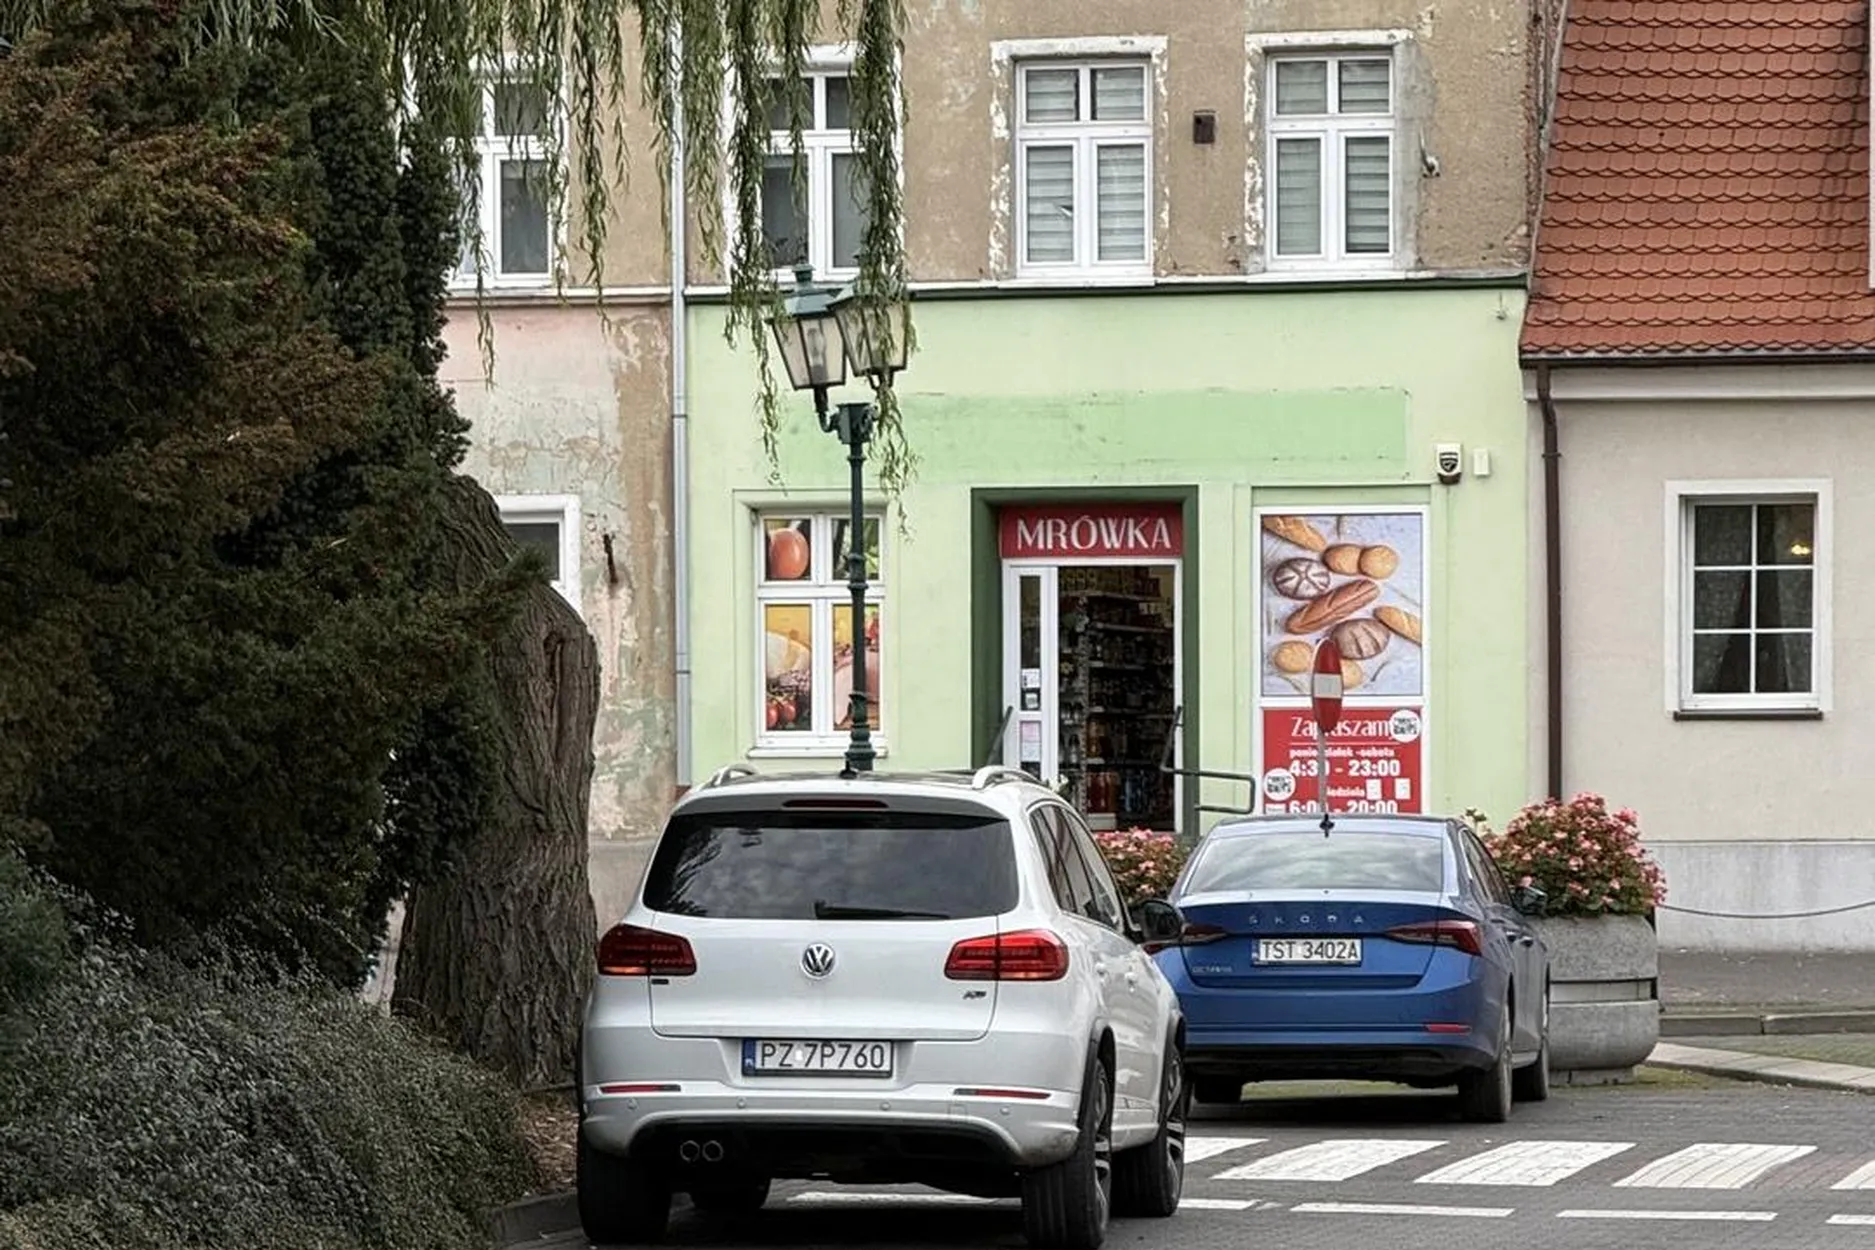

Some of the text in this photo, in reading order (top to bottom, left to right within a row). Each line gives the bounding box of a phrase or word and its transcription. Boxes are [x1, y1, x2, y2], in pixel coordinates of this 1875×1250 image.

[1017, 515, 1171, 549] MRÓWKA
[1348, 760, 1400, 776] 23:00
[1262, 941, 1359, 960] TST 3402A
[762, 1042, 885, 1069] PZ 7P760
